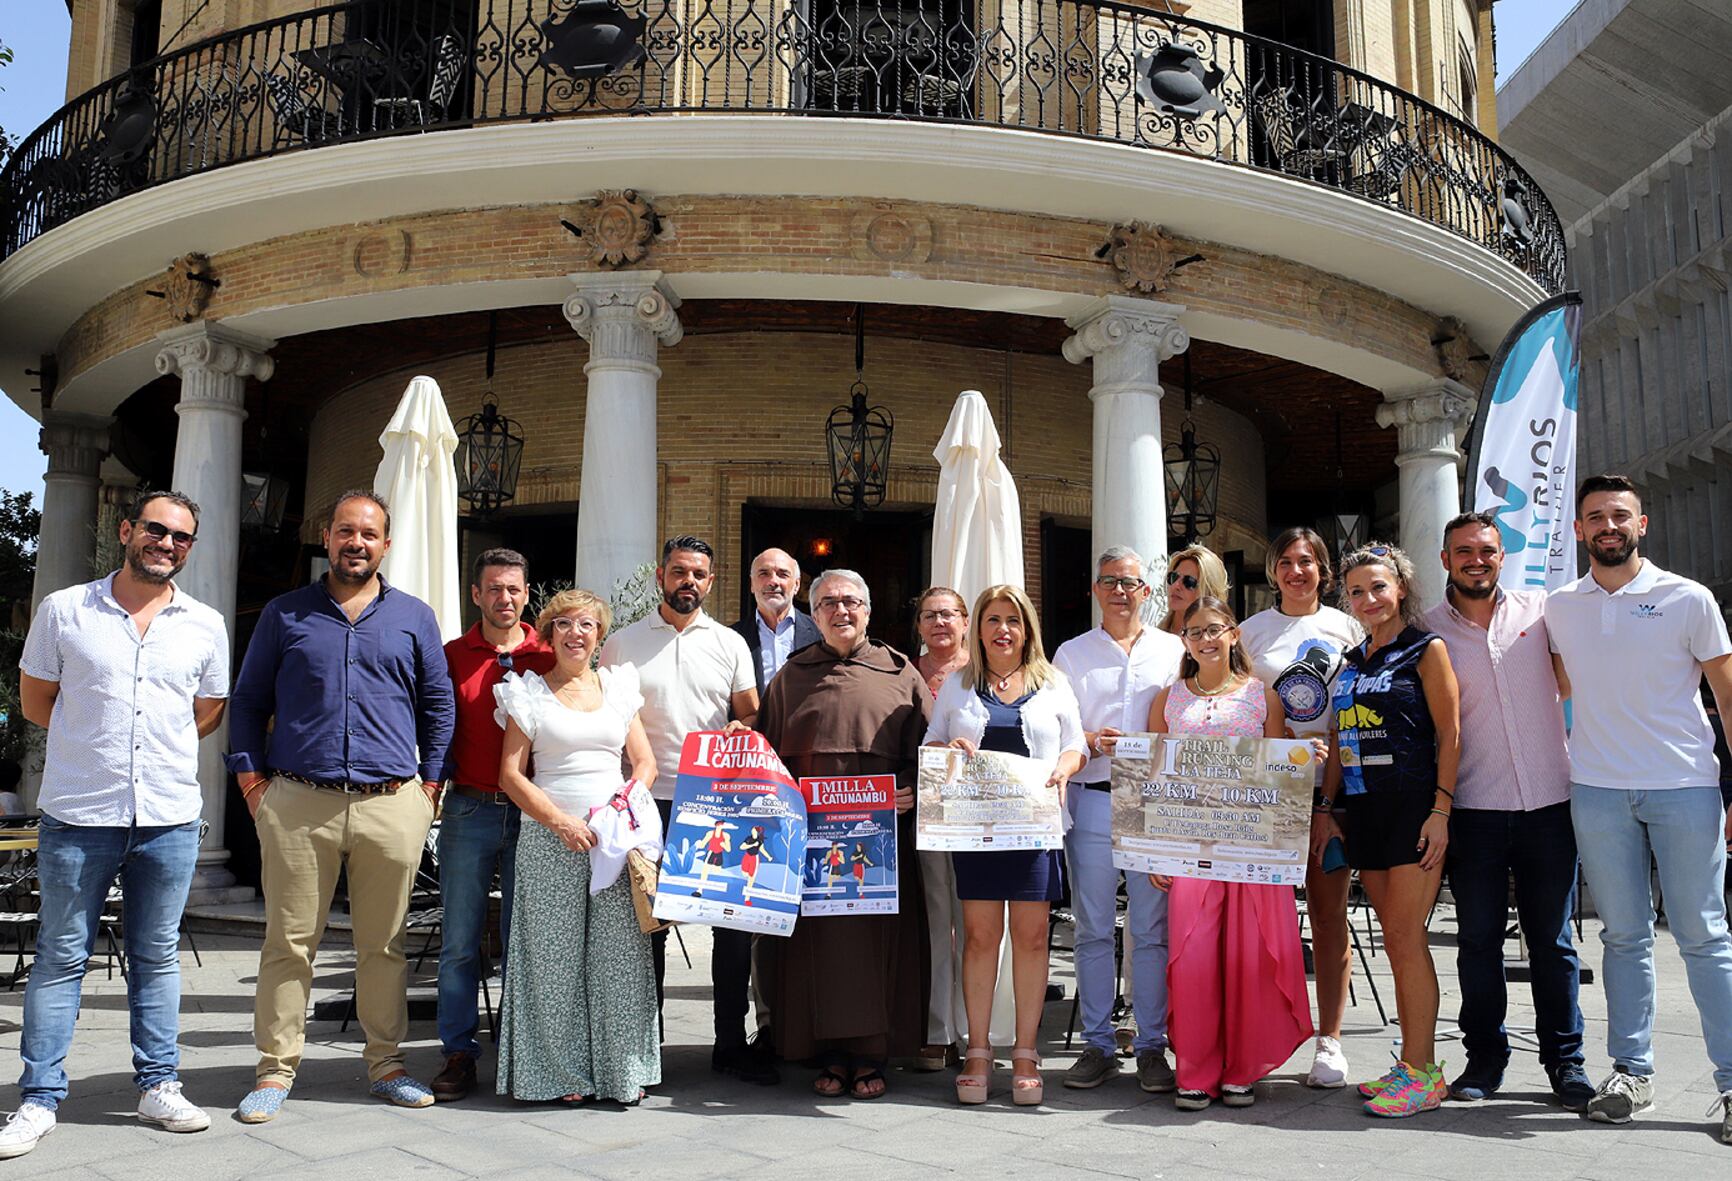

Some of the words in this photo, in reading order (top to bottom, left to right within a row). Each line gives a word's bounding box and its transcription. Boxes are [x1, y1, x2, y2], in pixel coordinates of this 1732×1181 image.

[1525, 418, 1557, 586] ILLYRIOS
[693, 734, 715, 767] I
[1160, 739, 1180, 776] I
[1181, 751, 1253, 768] RUNNING
[1180, 763, 1201, 777] LA
[1205, 766, 1242, 780] TEJA
[809, 782, 822, 806] I
[822, 779, 876, 793] MILLA
[821, 789, 887, 805] CATUNAMBÚ
[1142, 782, 1161, 797] 22
[1165, 782, 1198, 801] KM
[1221, 786, 1241, 804] 10
[1244, 786, 1280, 806] KM
